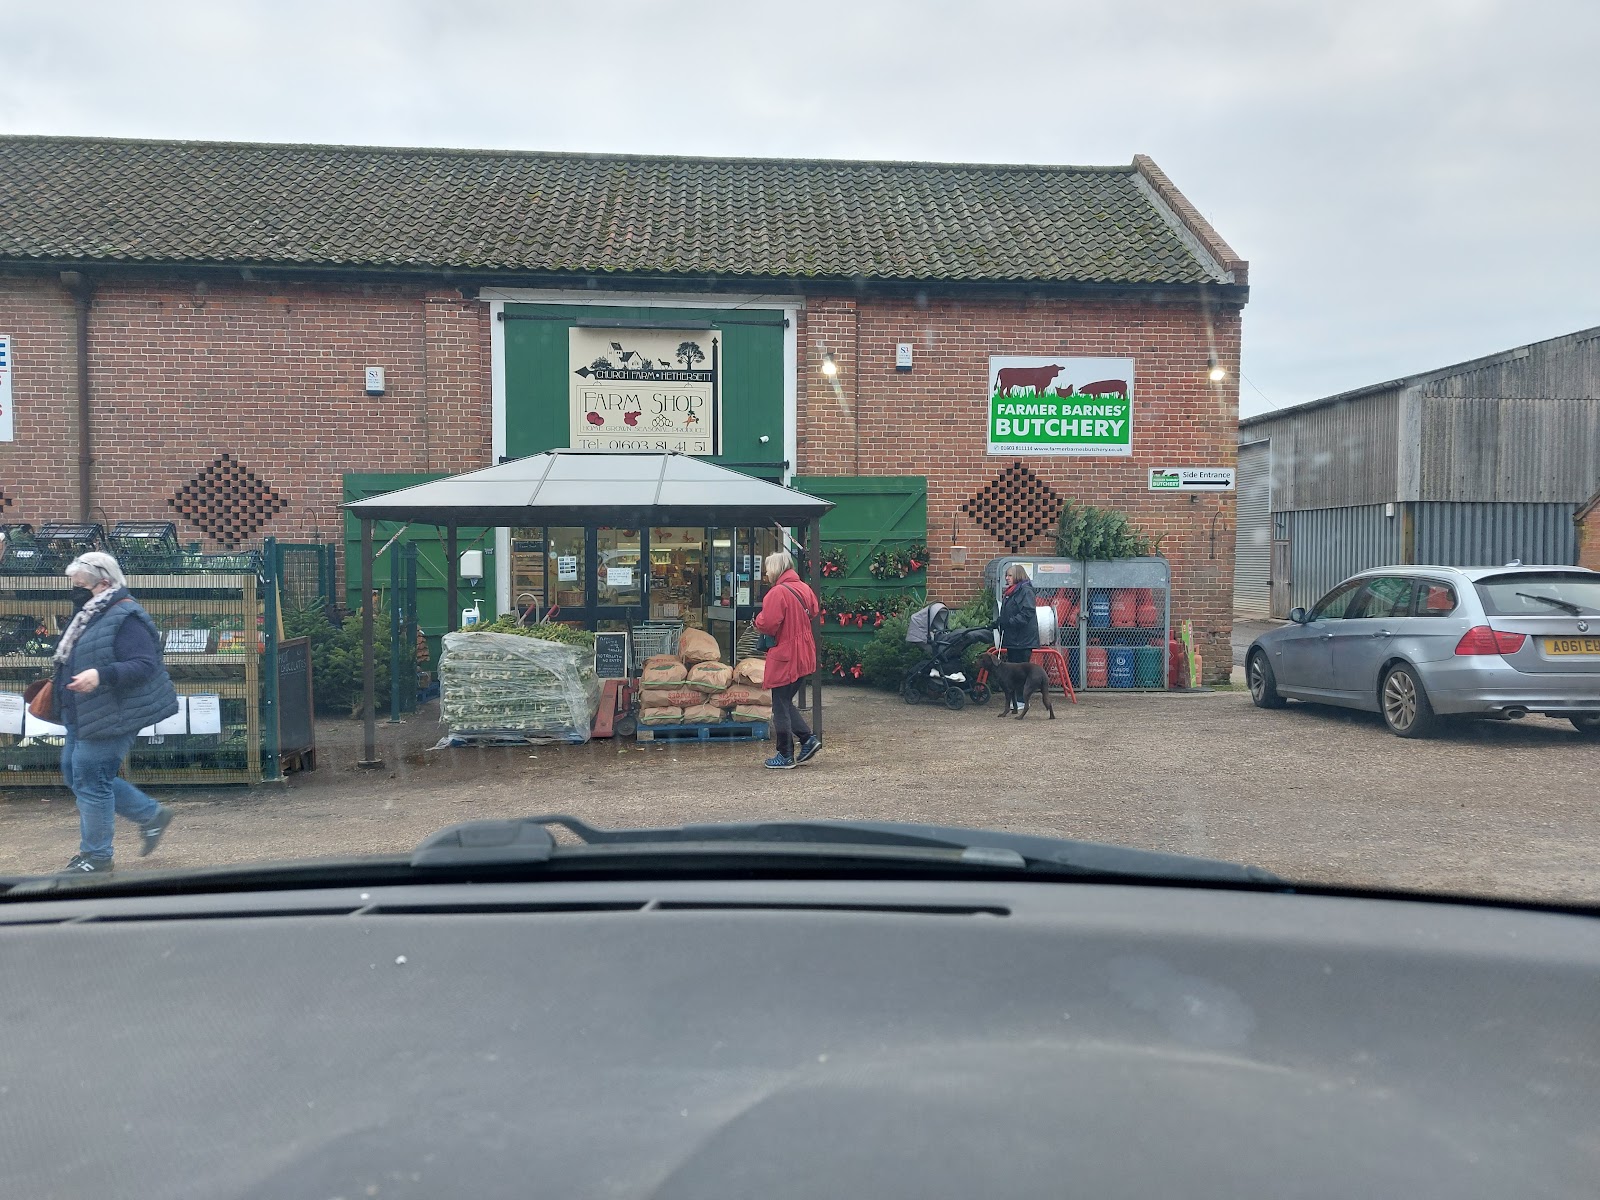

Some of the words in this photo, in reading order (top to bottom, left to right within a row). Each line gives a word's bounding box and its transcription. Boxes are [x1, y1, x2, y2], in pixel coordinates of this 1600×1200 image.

[596, 371, 629, 380] CHURCH
[631, 371, 656, 380] FARM
[661, 372, 712, 381] HETHERSETT
[584, 392, 642, 412] FARM
[650, 393, 703, 414] SHOP
[998, 404, 1057, 415] FARMER
[995, 418, 1125, 437] BUTCHERY
[609, 440, 649, 450] 01603
[655, 441, 667, 450] 81
[674, 441, 686, 451] 41
[694, 441, 706, 452] 51
